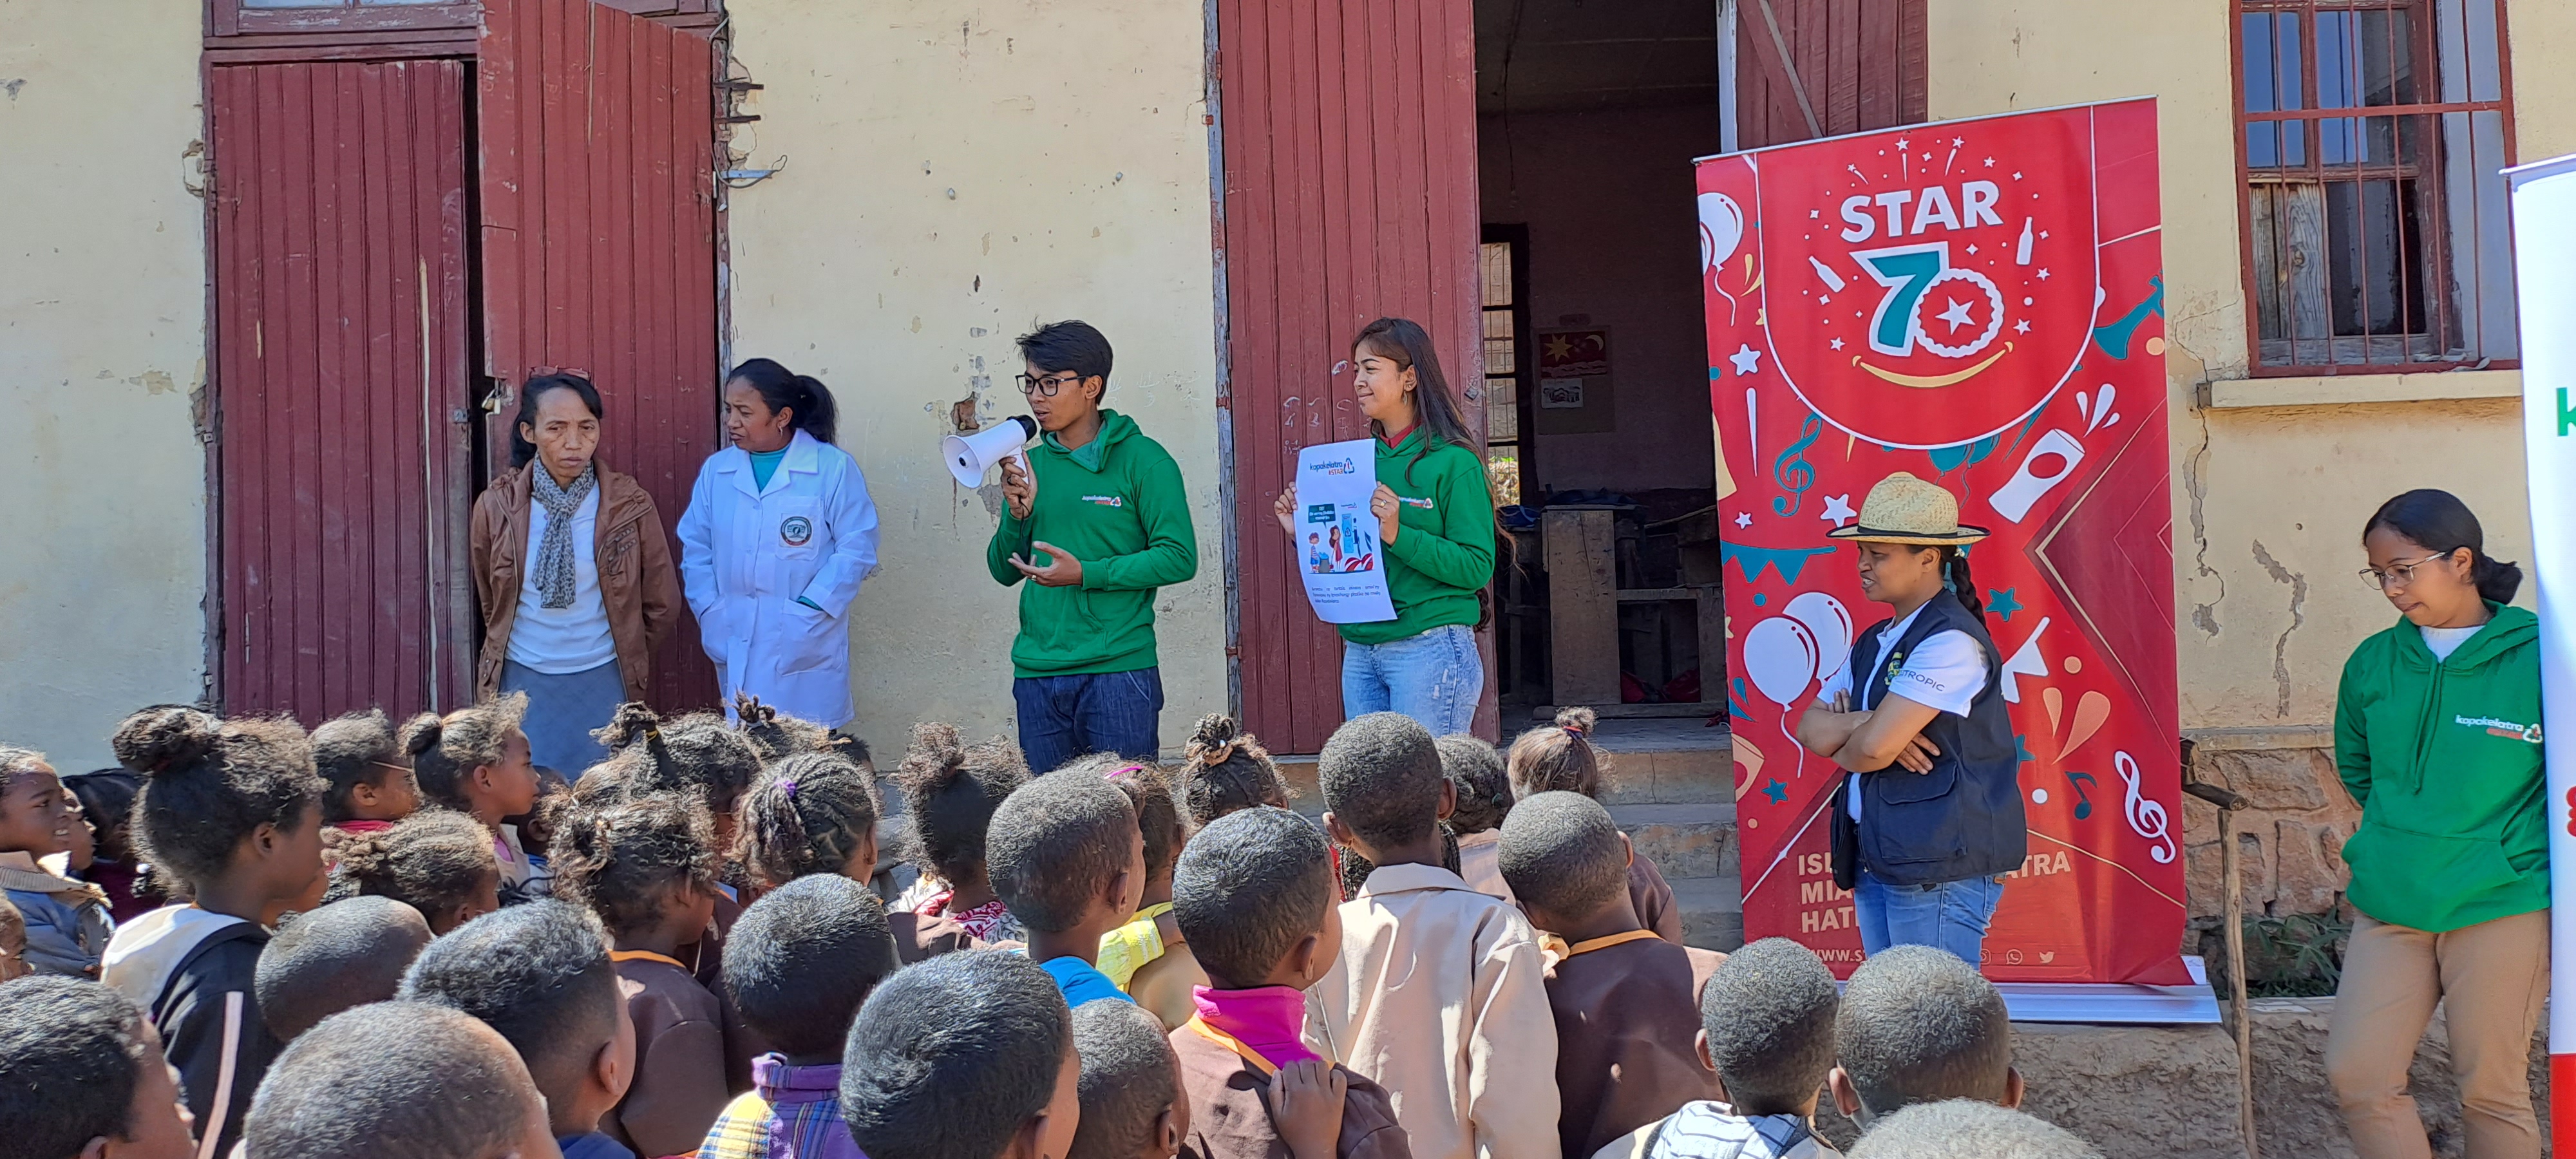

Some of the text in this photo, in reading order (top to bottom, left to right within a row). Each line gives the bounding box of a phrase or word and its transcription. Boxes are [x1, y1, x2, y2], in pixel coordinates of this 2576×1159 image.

[1841, 180, 2004, 243] STAR
[2006, 851, 2071, 878] TRA
[1802, 906, 1860, 934] HAT
